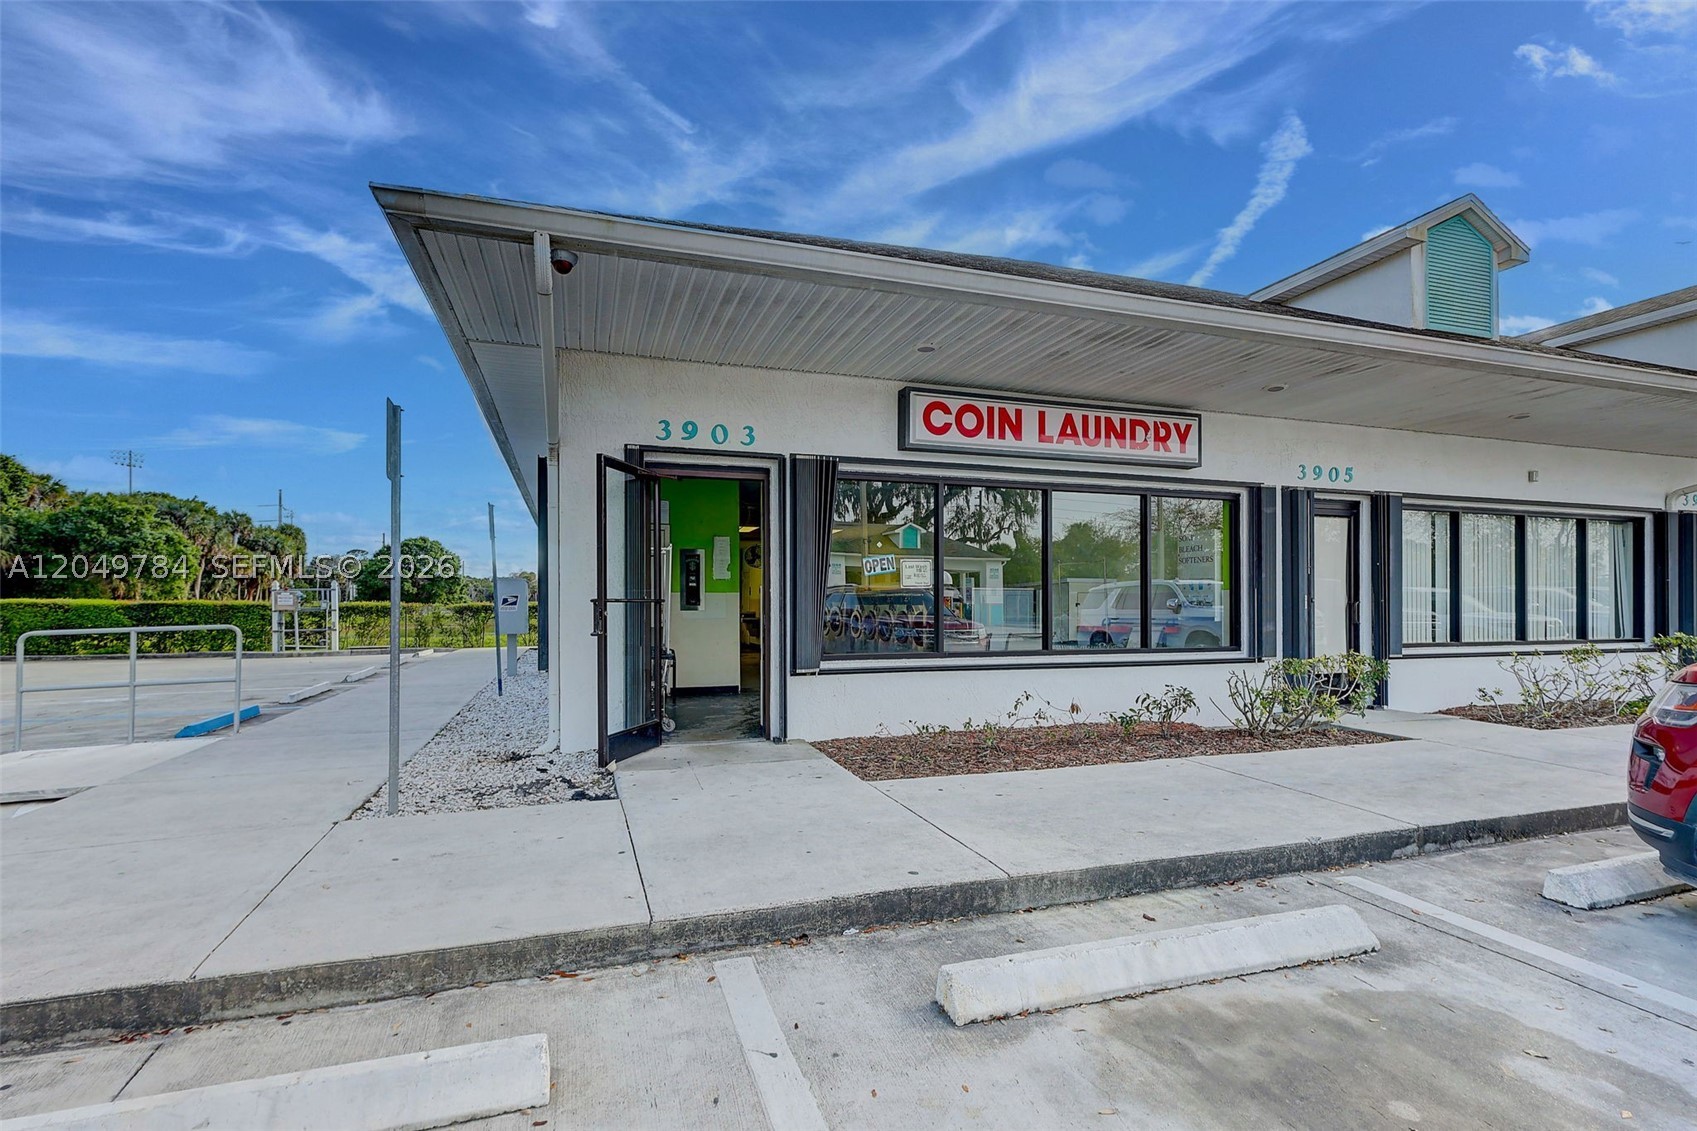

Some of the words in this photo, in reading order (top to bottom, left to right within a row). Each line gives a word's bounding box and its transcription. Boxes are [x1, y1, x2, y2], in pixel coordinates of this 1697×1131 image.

[655, 419, 756, 446] 3903
[922, 400, 1023, 442] COIN
[1037, 410, 1193, 454] LAUNDRY
[1297, 464, 1354, 483] 3905
[1179, 545, 1203, 553] BLEACH
[864, 556, 895, 574] OPEN
[1179, 556, 1214, 564] SOFTENERS
